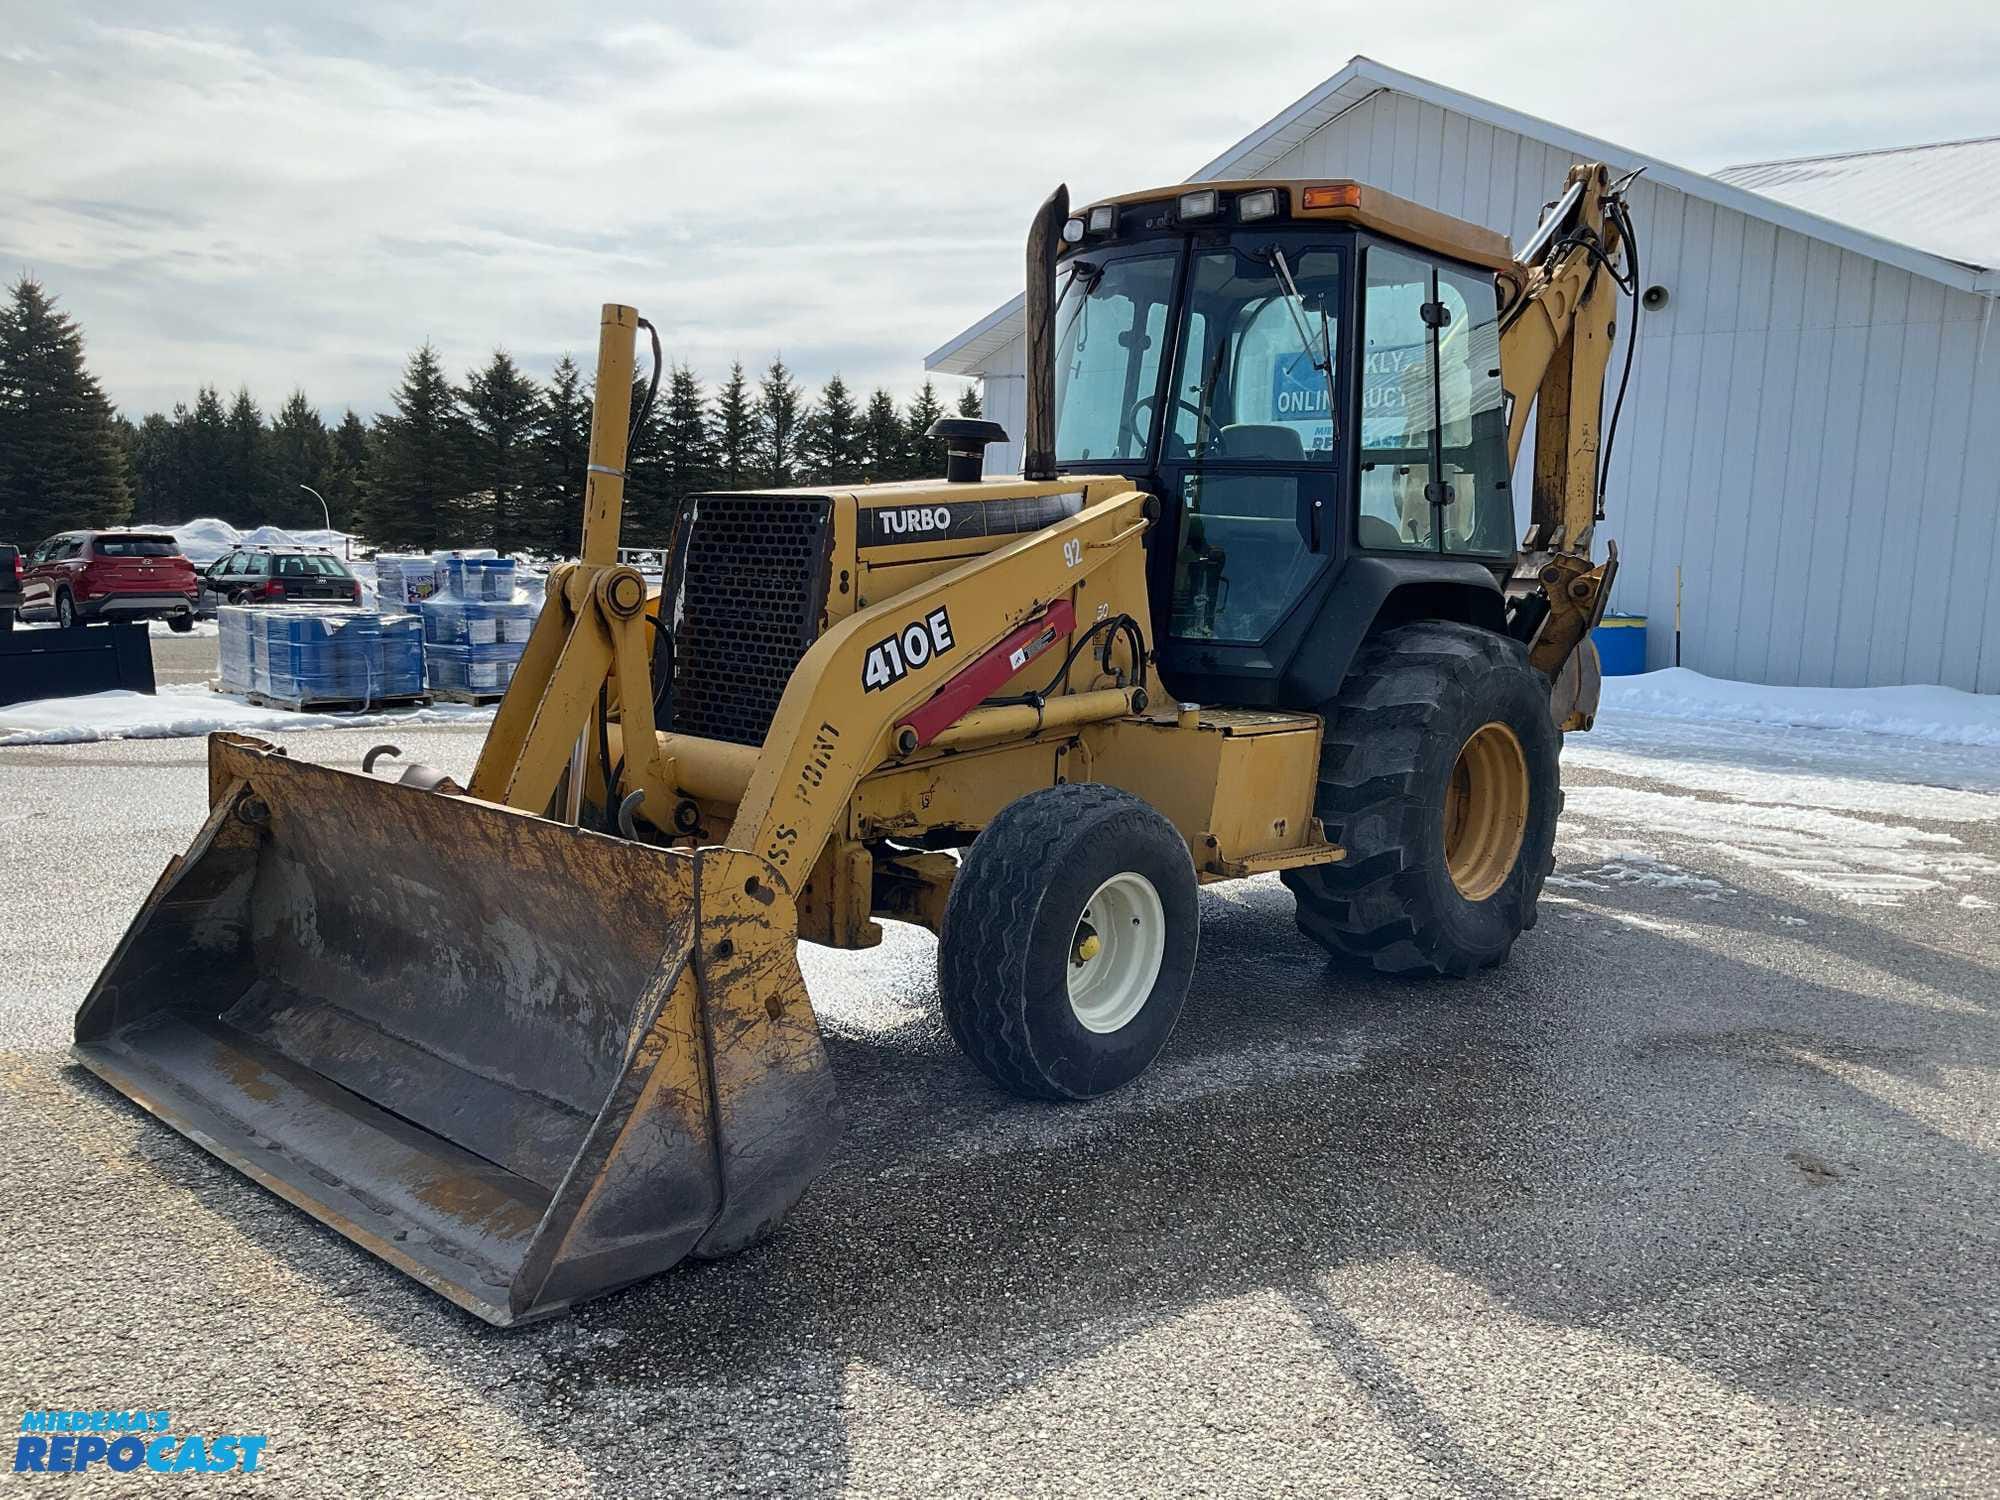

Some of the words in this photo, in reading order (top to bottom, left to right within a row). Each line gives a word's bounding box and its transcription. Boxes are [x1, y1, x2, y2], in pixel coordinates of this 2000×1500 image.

[879, 507, 951, 534] TURBO
[1063, 538, 1083, 568] 92
[864, 606, 954, 692] 410E
